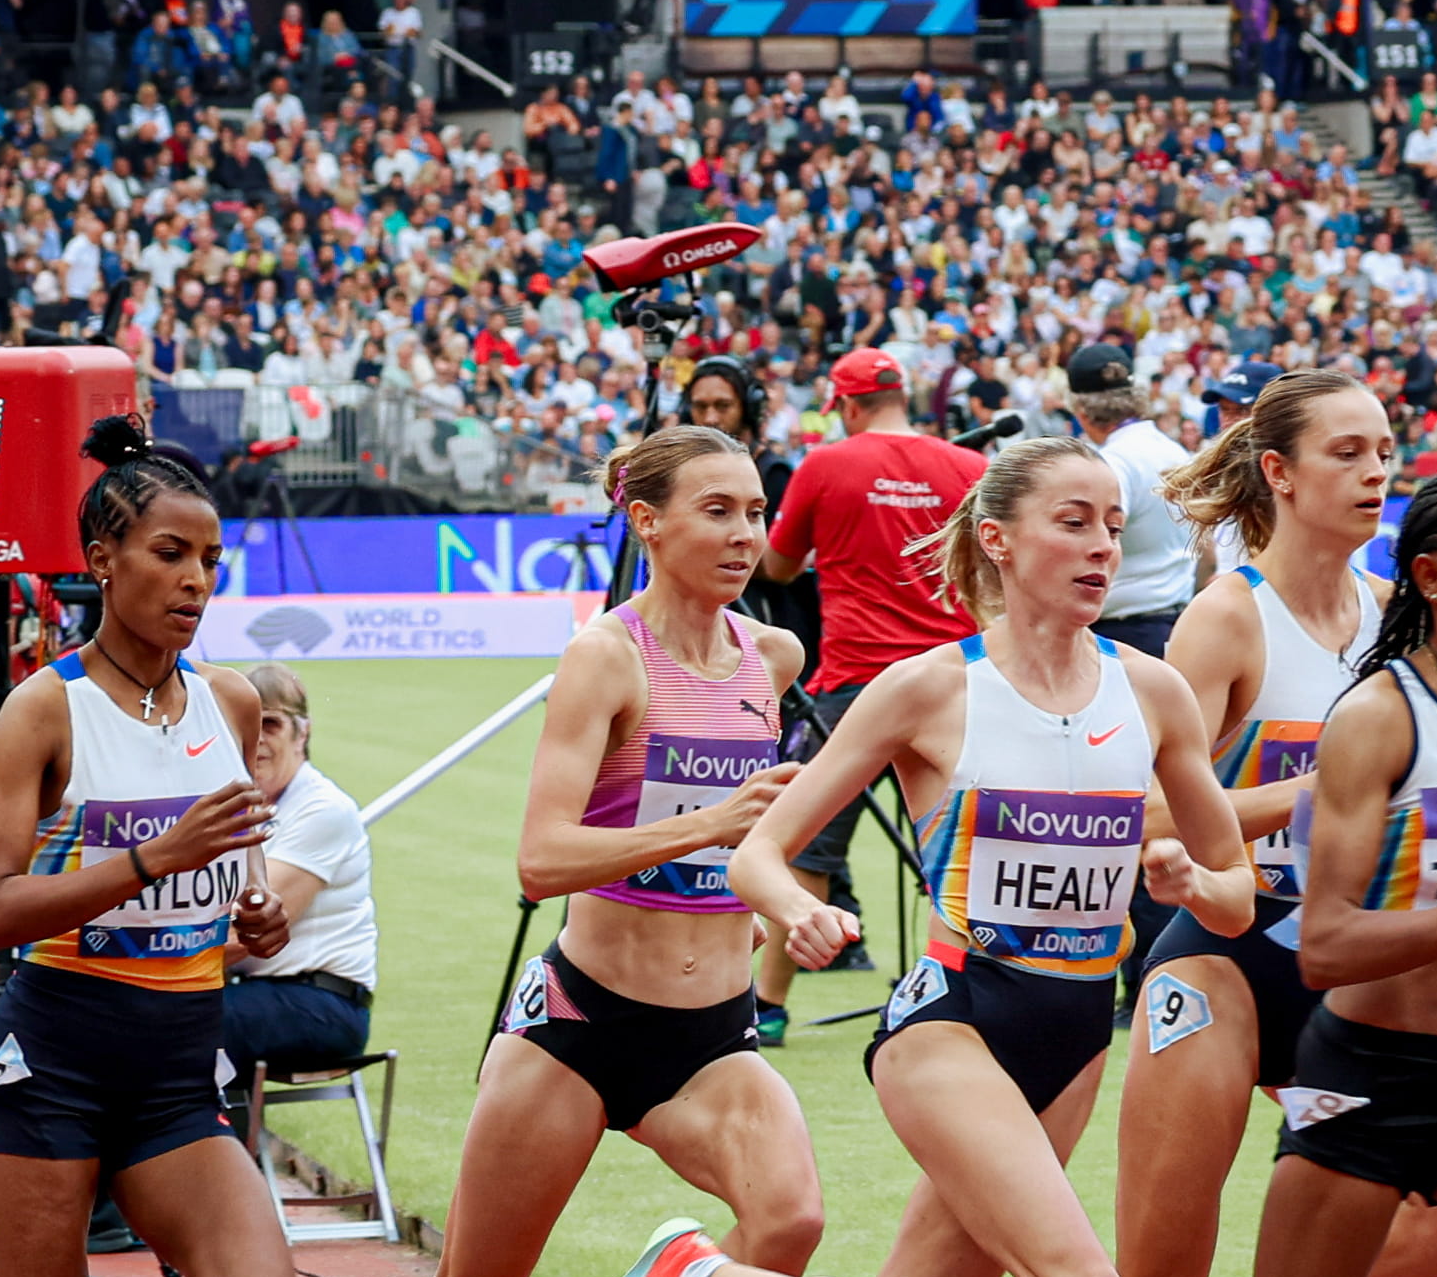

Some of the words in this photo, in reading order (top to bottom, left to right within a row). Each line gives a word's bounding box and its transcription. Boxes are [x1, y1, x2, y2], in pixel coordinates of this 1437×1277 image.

[528, 49, 576, 76] 152
[1373, 43, 1419, 69] 151
[681, 238, 739, 264] OMEGA
[343, 606, 442, 629] WORLD
[341, 628, 487, 652] ATHLETICS
[997, 801, 1134, 841] Novuna
[993, 860, 1125, 914] HEALY
[148, 925, 220, 953] LONDON
[1032, 932, 1107, 954] LONDON
[1161, 991, 1185, 1026] 9
